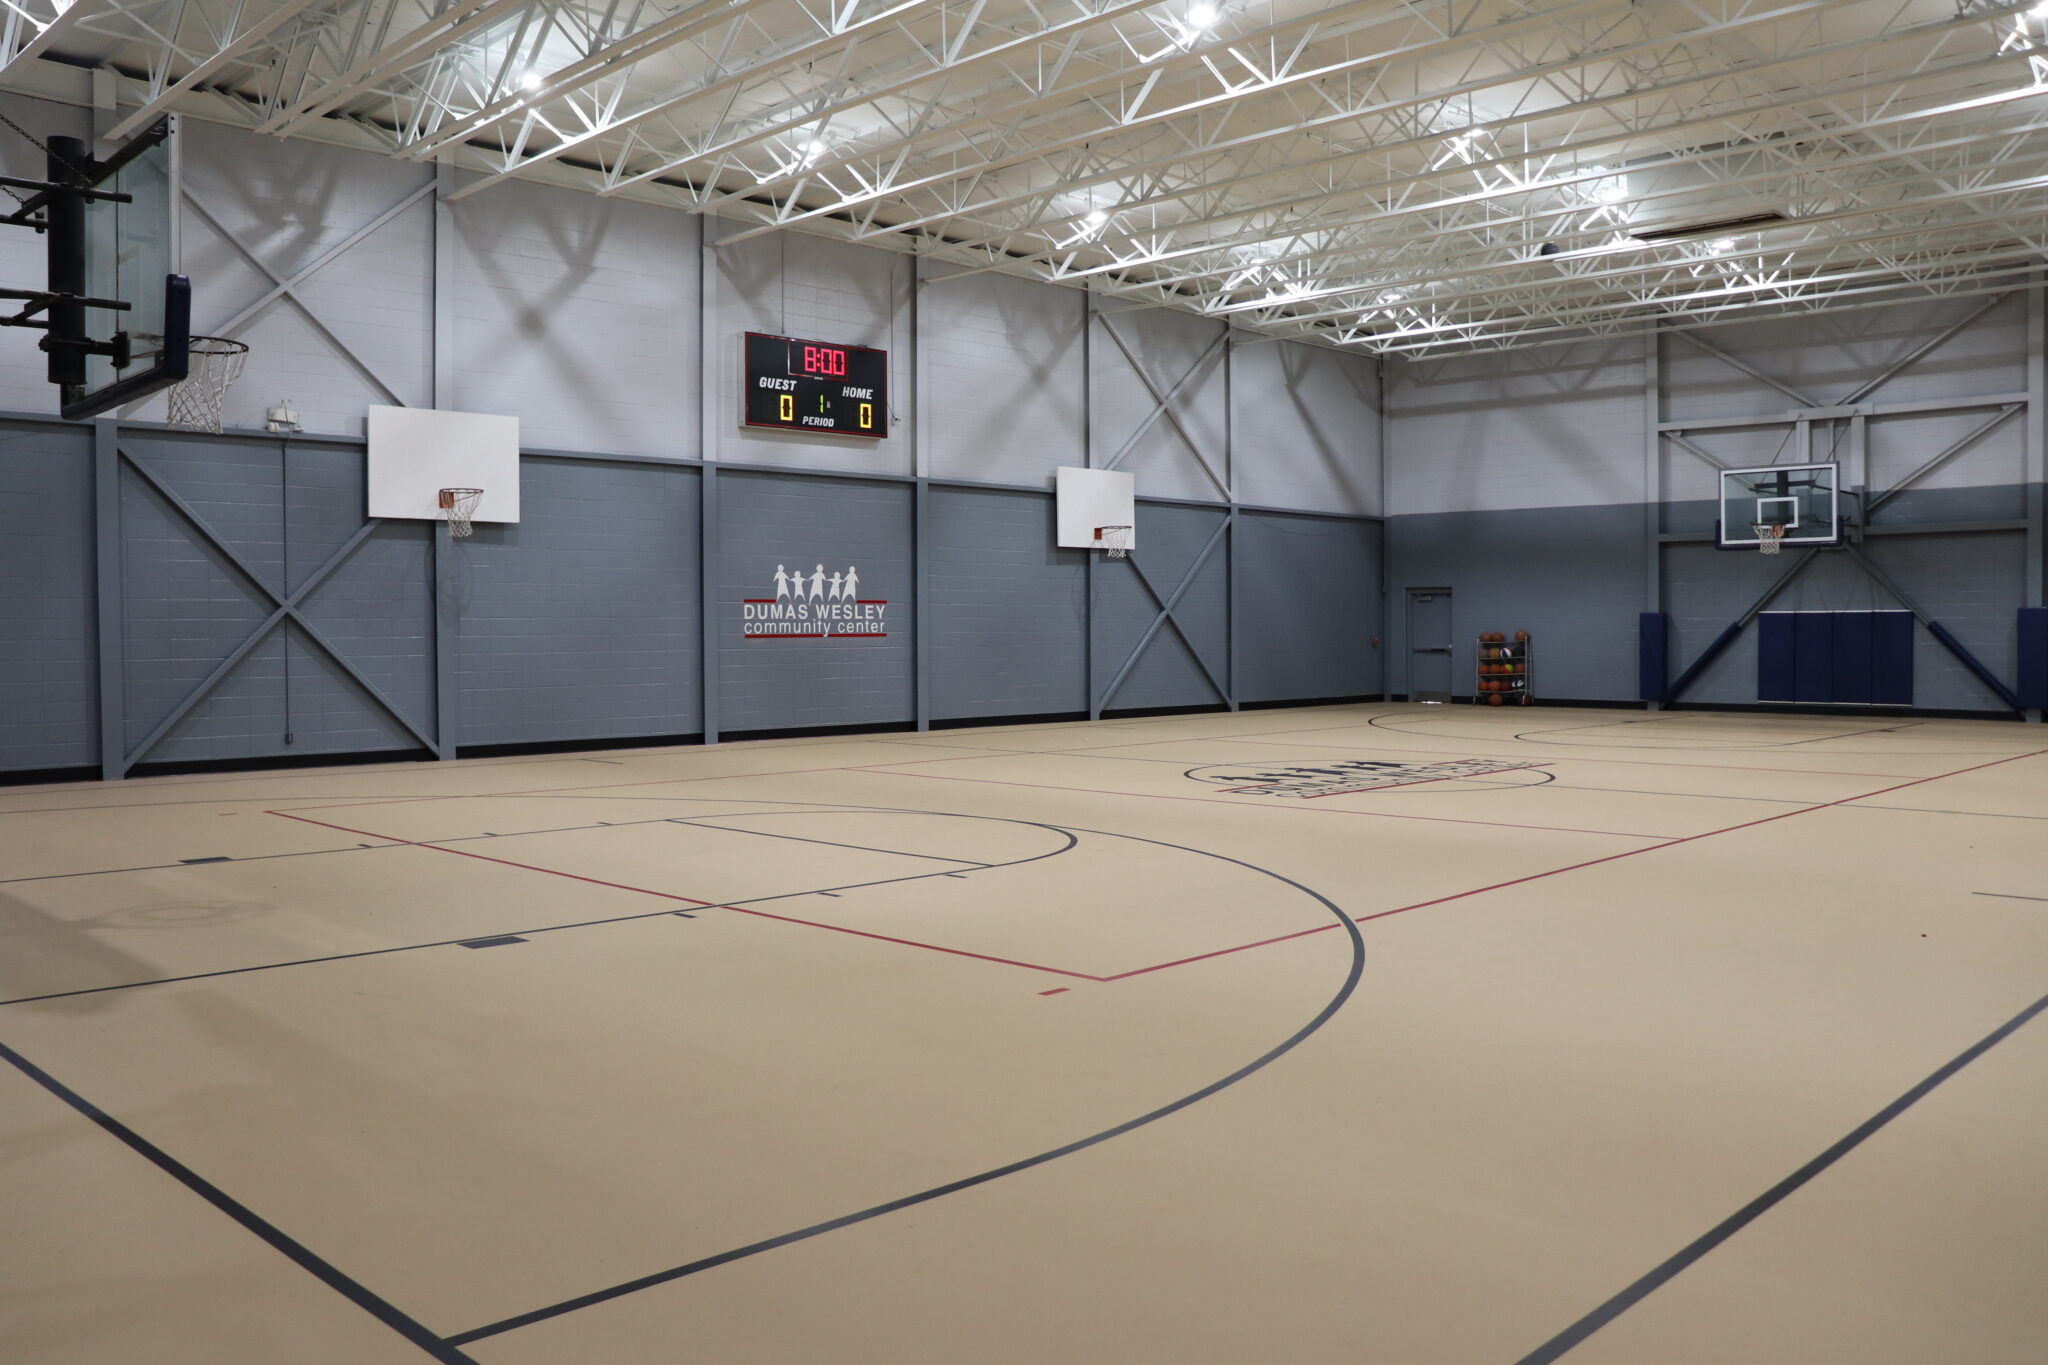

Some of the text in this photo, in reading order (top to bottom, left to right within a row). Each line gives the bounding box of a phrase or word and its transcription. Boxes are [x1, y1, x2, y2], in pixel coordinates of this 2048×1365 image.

[804, 346, 845, 375] 8:00
[759, 376, 797, 391] GUEST
[842, 386, 873, 399] HOME
[780, 394, 793, 421] 0
[819, 394, 824, 413] 1
[802, 416, 834, 427] PERIOD
[859, 403, 872, 429] 0
[743, 604, 886, 620] DUMAS WESLEY
[744, 619, 885, 637] community center
